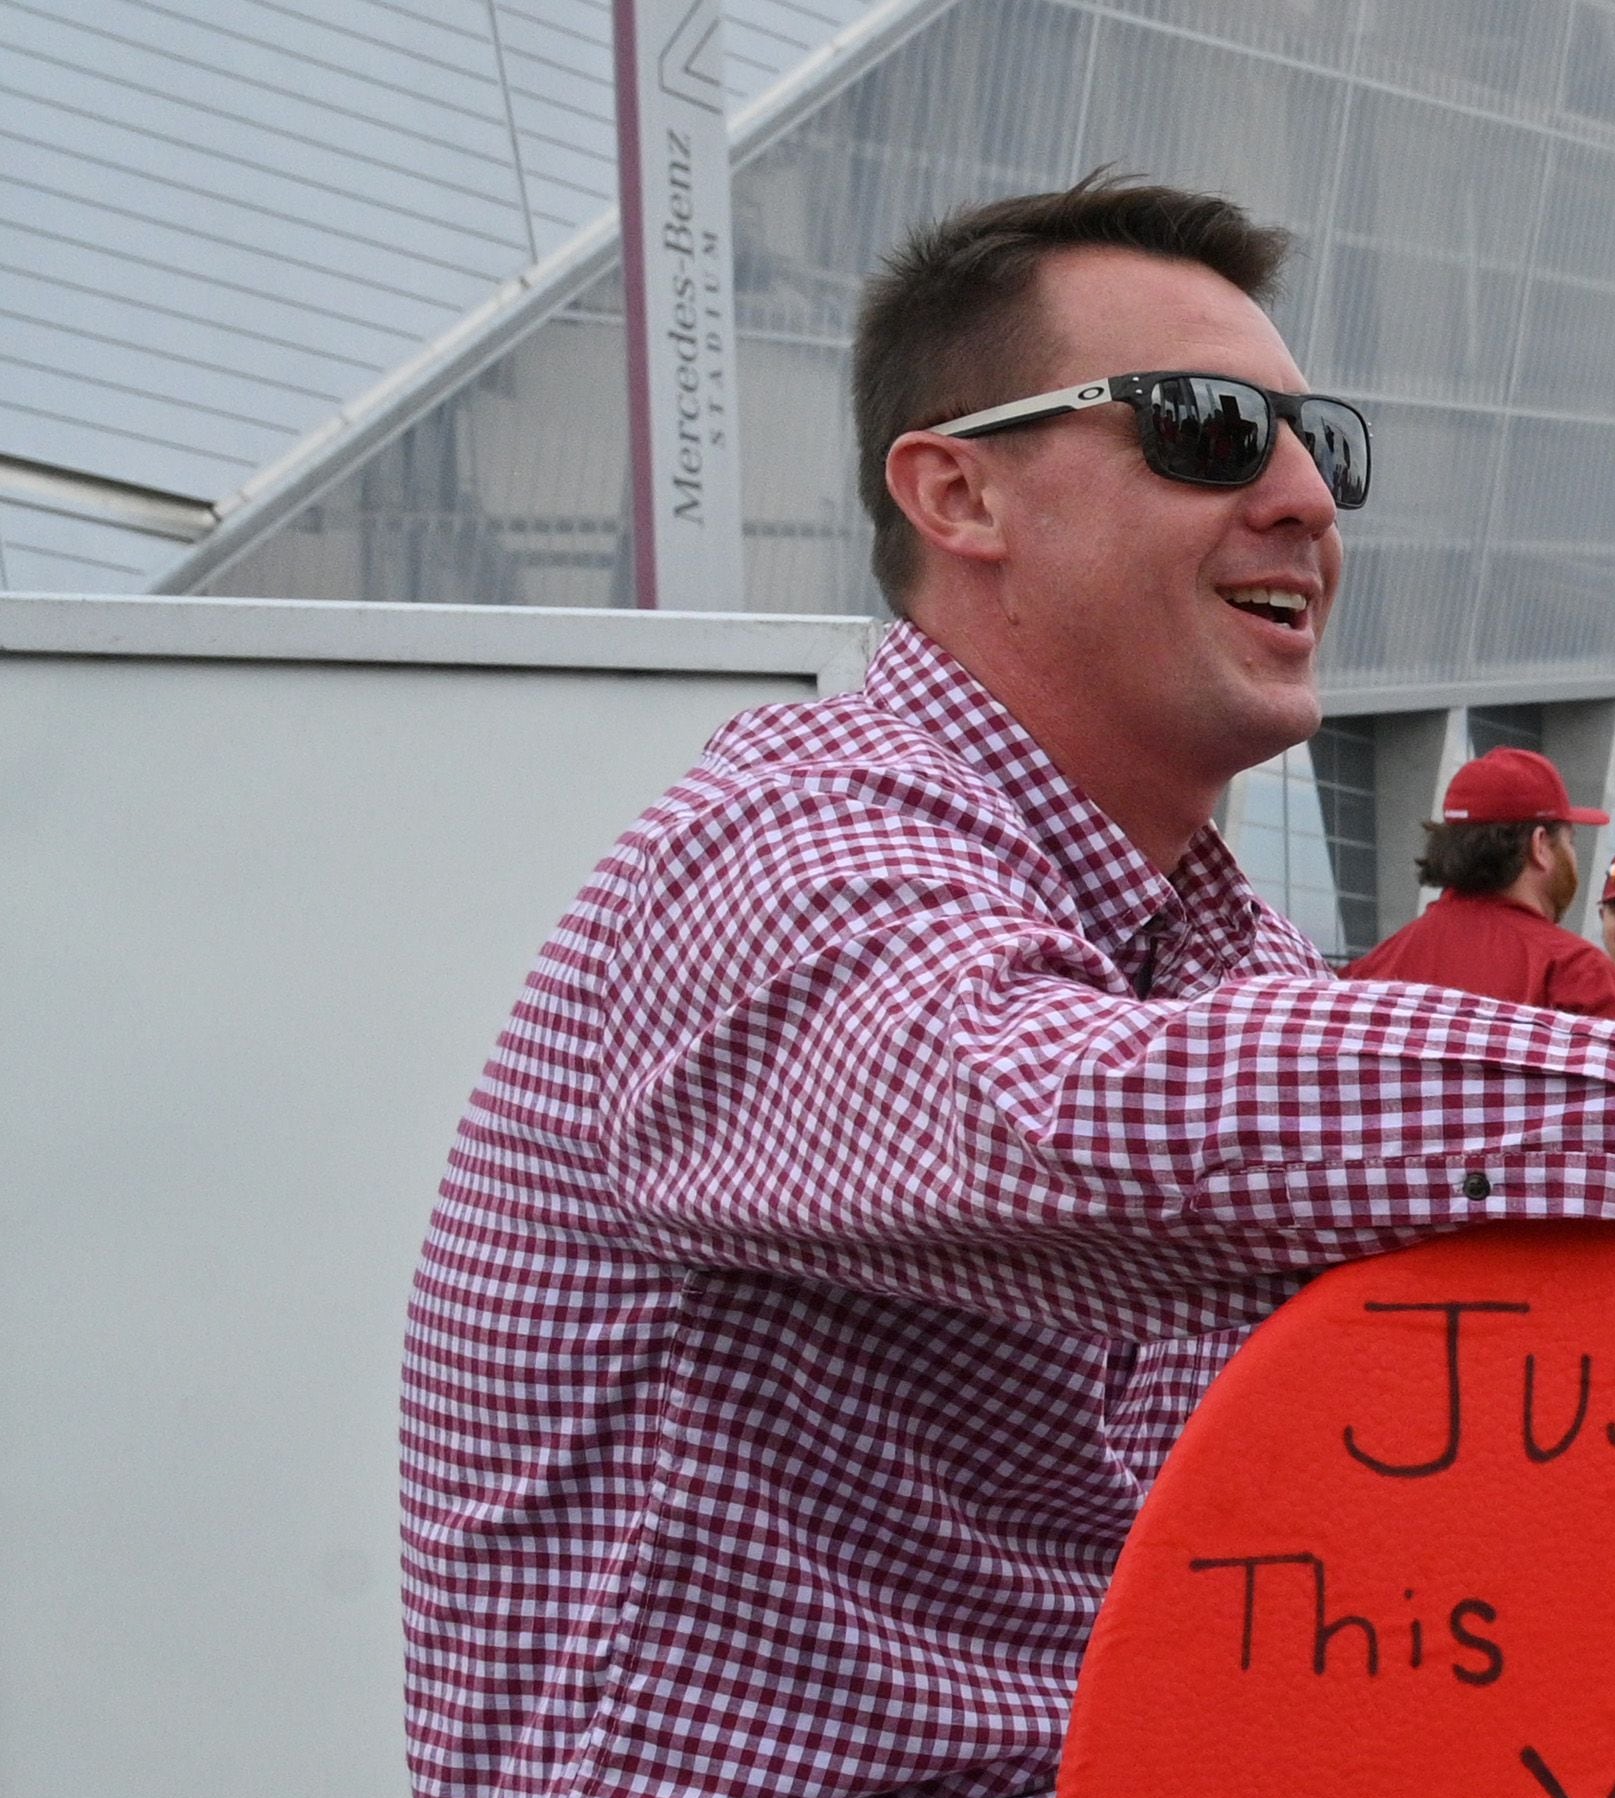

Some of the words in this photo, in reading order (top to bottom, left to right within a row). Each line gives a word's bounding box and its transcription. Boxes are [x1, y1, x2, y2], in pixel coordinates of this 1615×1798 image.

[663, 128, 704, 526] Mercedes-Benz
[702, 231, 726, 449] STADIUM
[1190, 1553, 1504, 1686] This
